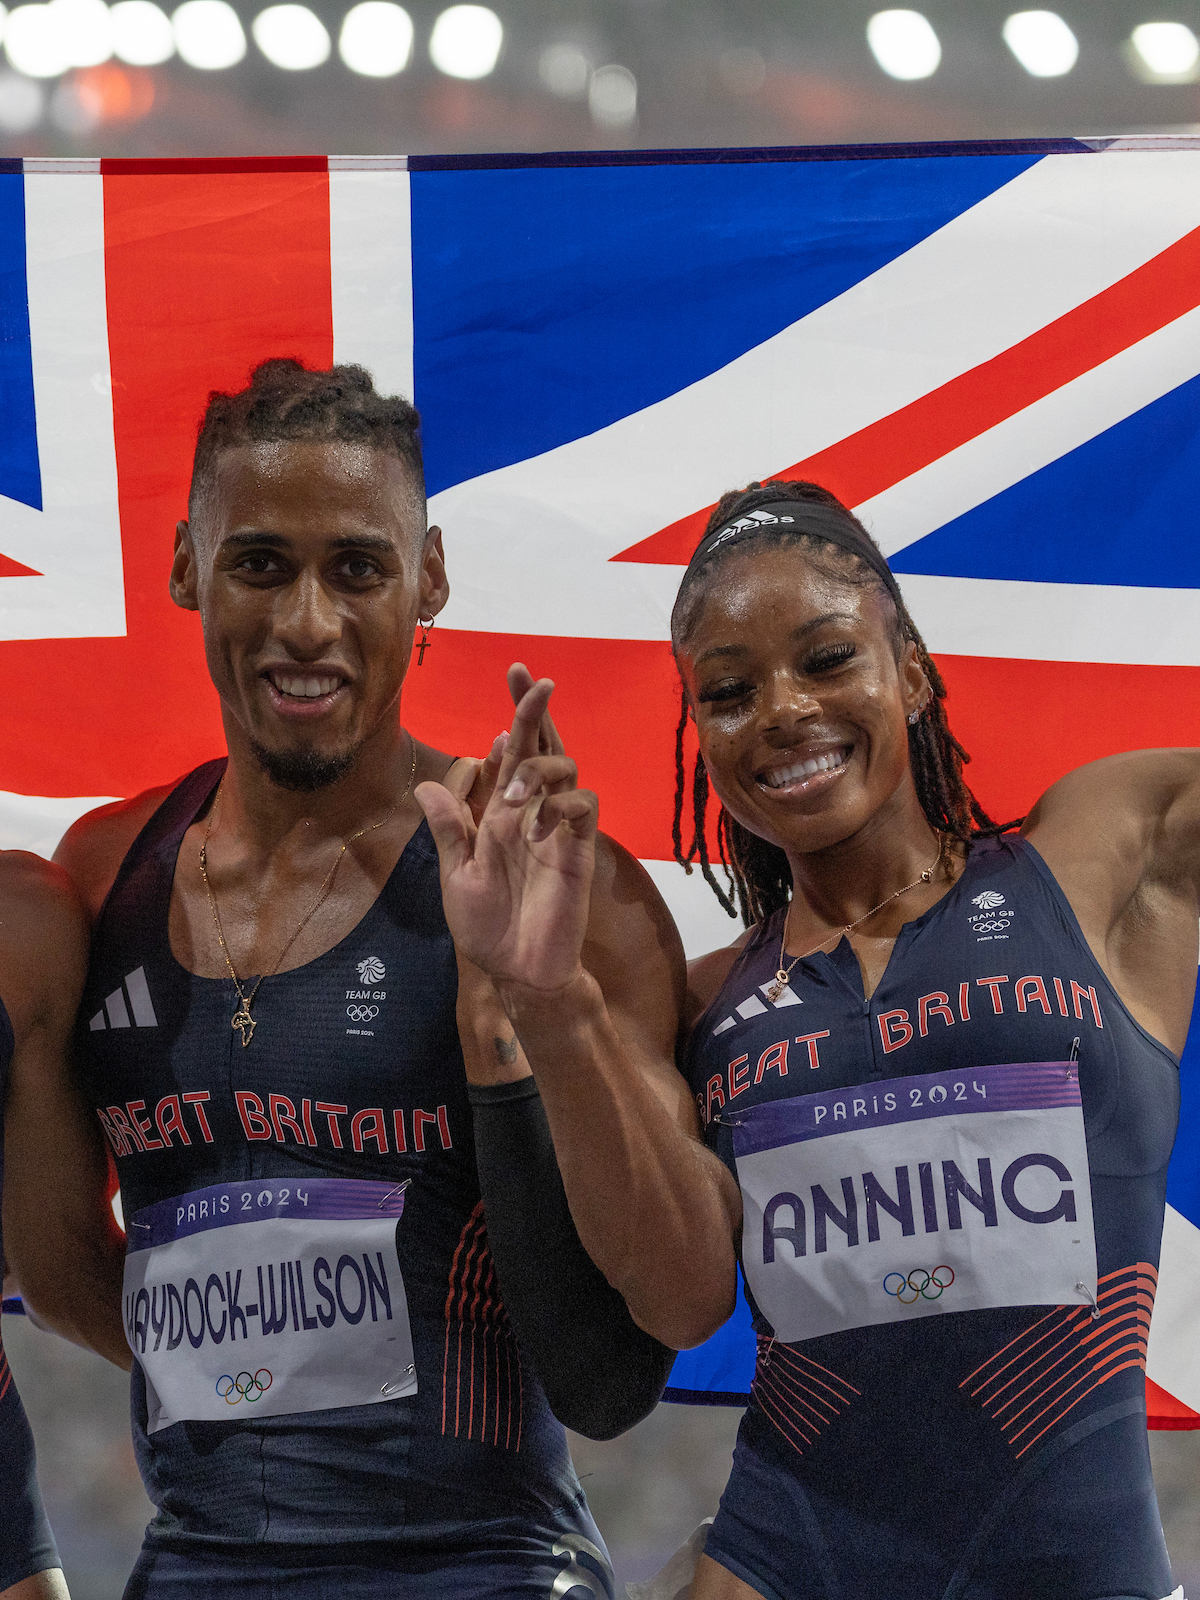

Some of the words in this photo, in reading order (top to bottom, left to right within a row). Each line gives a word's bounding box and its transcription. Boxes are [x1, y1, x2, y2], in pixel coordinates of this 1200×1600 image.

[707, 515, 795, 552] adidas
[967, 911, 996, 923] TEAM
[345, 990, 371, 1000] TEAM
[372, 990, 387, 1000] GB
[877, 974, 1104, 1055] BRITAIN
[909, 1080, 987, 1108] 2024
[96, 1090, 215, 1157] GREAT
[234, 1090, 454, 1155] BRITAIN
[240, 1188, 309, 1211] 2024
[761, 1152, 1078, 1265] ANNING
